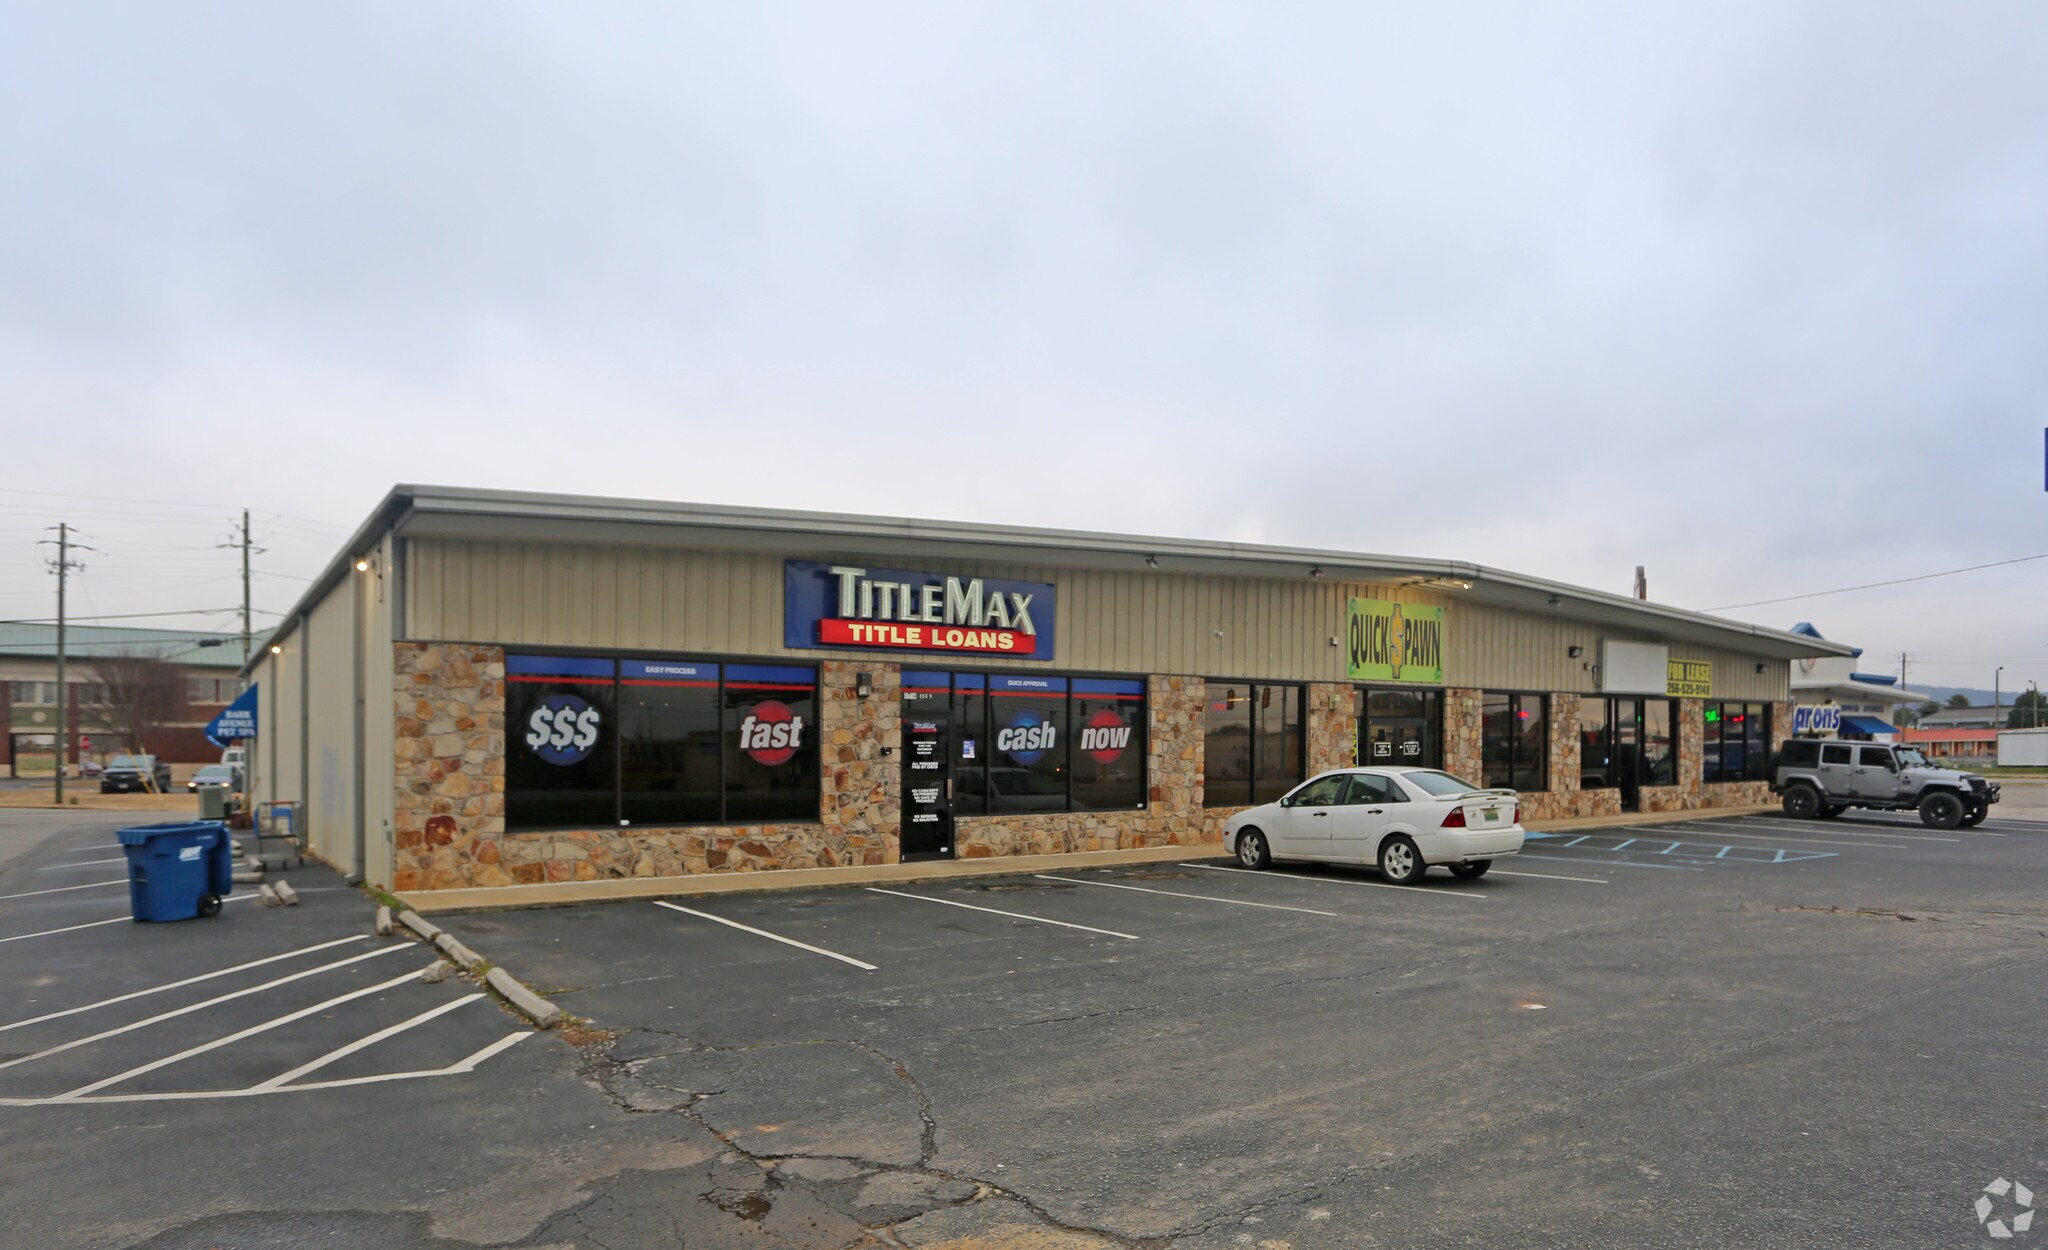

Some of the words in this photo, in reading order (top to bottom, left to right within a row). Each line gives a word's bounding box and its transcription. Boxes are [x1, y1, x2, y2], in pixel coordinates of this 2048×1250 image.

[848, 623, 922, 645] TITLE
[931, 628, 1015, 650] LOANS
[1350, 612, 1389, 669] QUICK
[1404, 618, 1441, 669] PAWN
[1667, 661, 1684, 681] FOR
[1686, 662, 1711, 683] LEASE
[526, 705, 599, 751] $$$
[740, 716, 803, 749] fast
[997, 720, 1056, 751] cash
[1081, 727, 1131, 750] now
